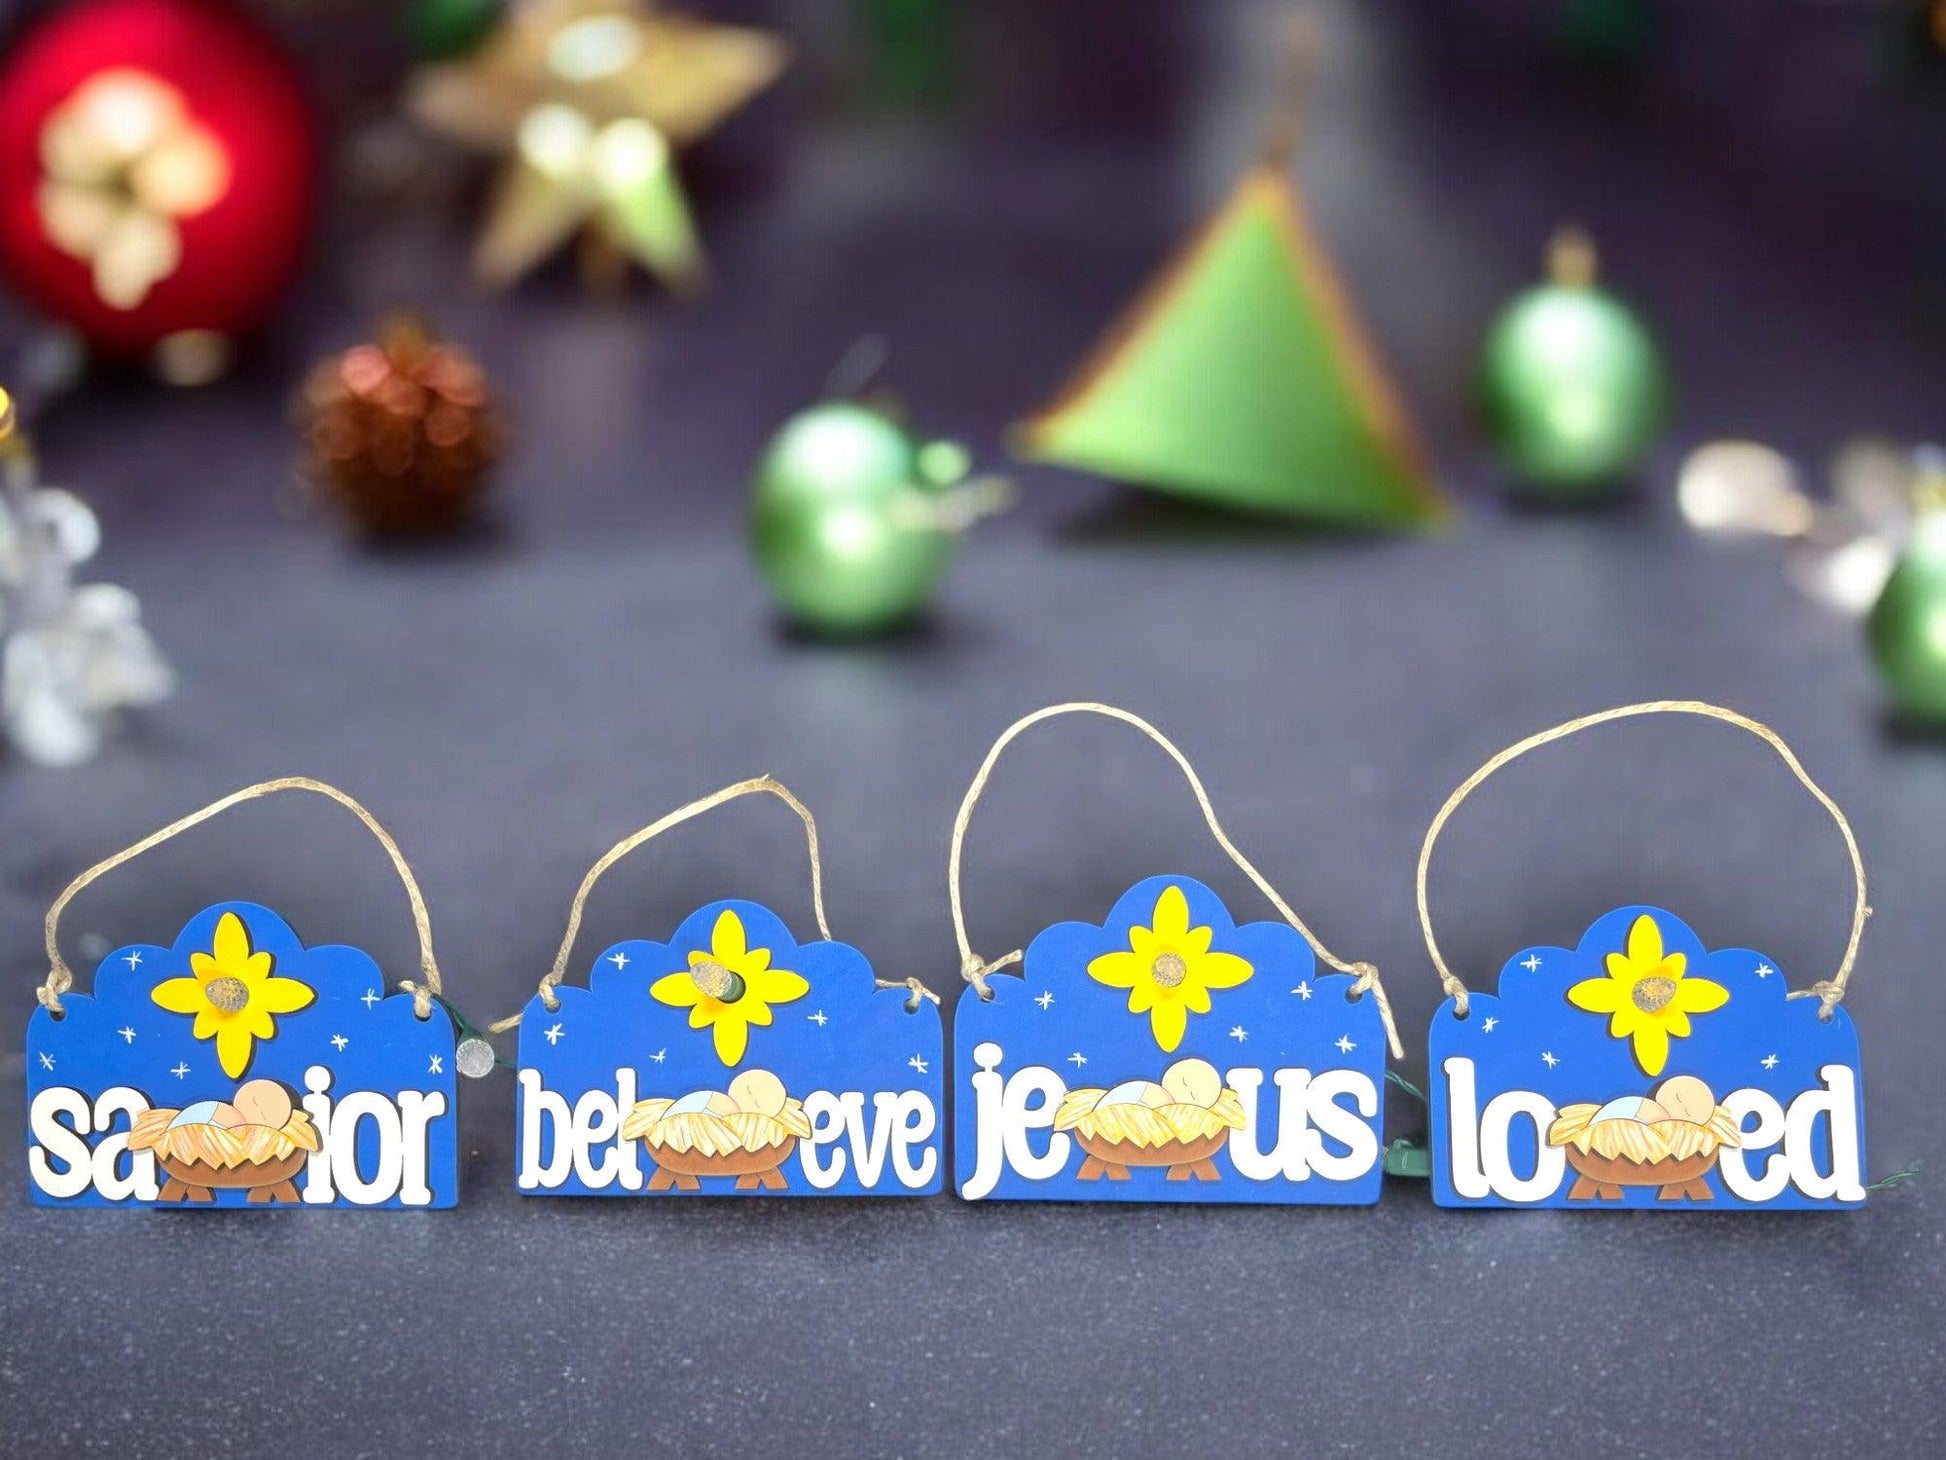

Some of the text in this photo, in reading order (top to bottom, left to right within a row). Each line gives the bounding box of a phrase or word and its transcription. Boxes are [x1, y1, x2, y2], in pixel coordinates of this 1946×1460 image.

[28, 1066, 446, 1206] saior
[519, 1068, 938, 1191] beleve
[961, 1042, 1379, 1202] jeus
[1443, 1057, 1867, 1204] loed
